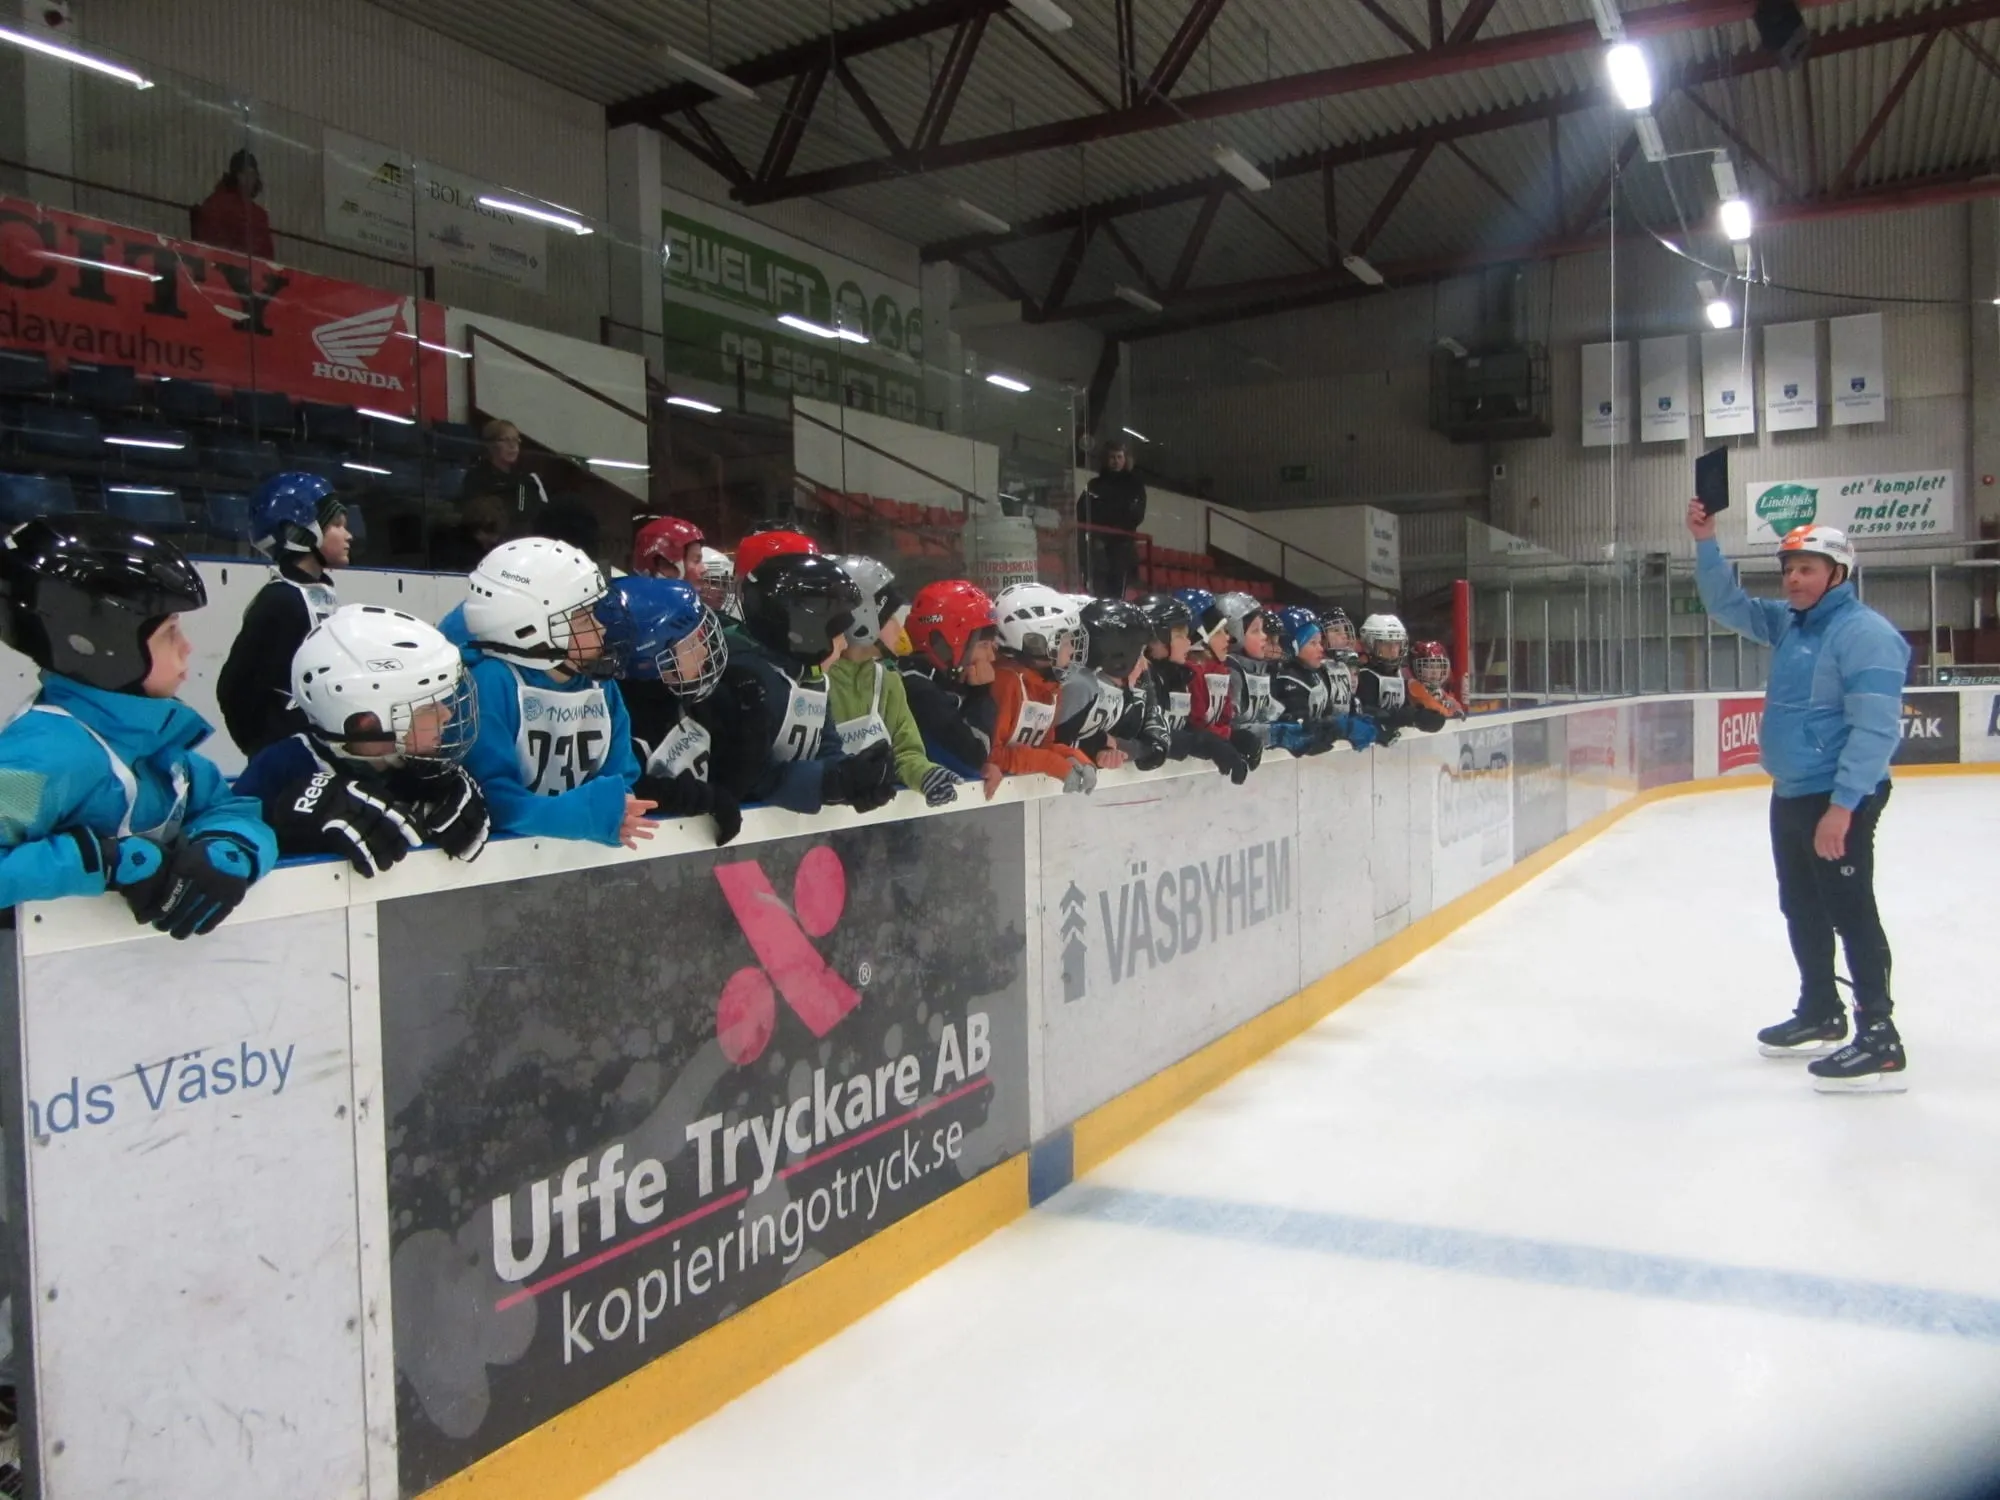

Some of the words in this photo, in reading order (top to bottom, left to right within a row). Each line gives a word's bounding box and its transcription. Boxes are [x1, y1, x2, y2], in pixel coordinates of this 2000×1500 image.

[0, 208, 290, 336] CITY
[663, 226, 816, 316] SWELIFT
[312, 361, 403, 392] HONDA
[1840, 479, 1864, 496] ett
[1874, 475, 1946, 495] komplett
[500, 569, 531, 585] Reebok
[839, 723, 884, 745] KAMPEN
[1721, 711, 1762, 752] GEVA
[1898, 717, 1942, 738] TAK
[294, 771, 336, 813] Reeb
[1099, 836, 1290, 985] VÄSBYHEM
[135, 1041, 295, 1111] Väsby
[491, 1144, 667, 1284] Uffe
[686, 1051, 920, 1197] Tryckare
[932, 1012, 993, 1093] AB
[561, 1114, 965, 1364] kopieringotryck.se
